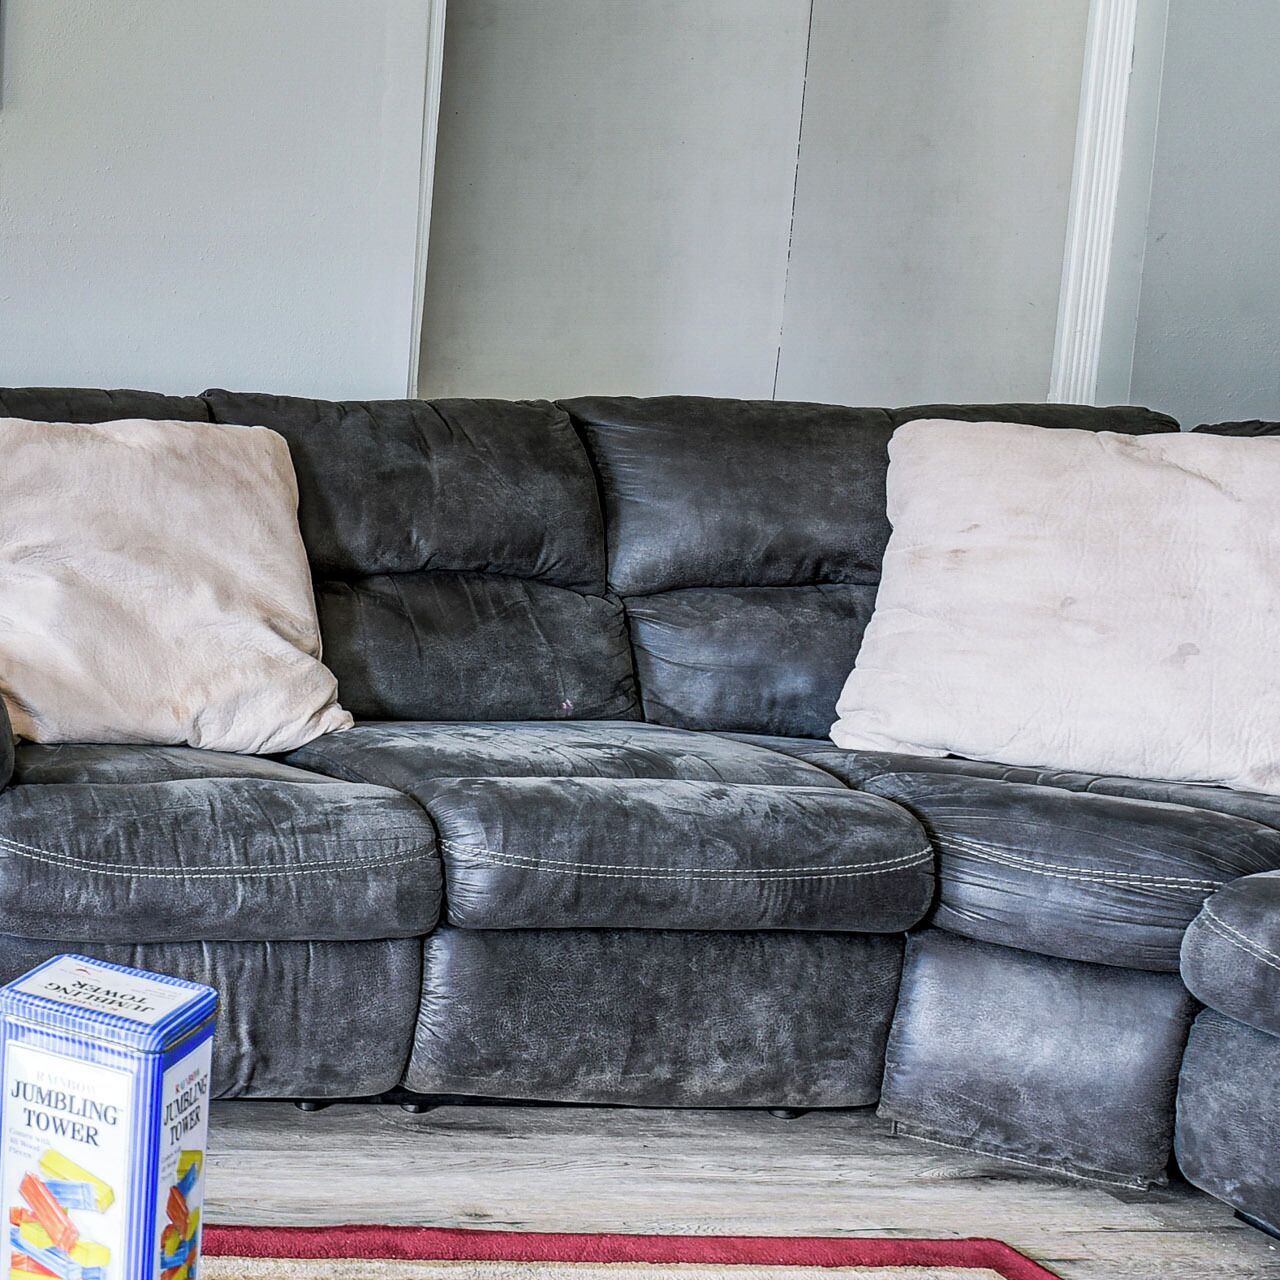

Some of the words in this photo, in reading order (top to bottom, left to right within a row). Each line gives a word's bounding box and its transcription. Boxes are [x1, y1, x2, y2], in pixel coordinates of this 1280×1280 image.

[44, 982, 155, 1013] JUMBLING
[72, 980, 147, 1005] TOWER
[11, 1079, 119, 1126] JUMBLING
[24, 1107, 100, 1147] TOWER
[170, 1105, 201, 1146] TOWER
